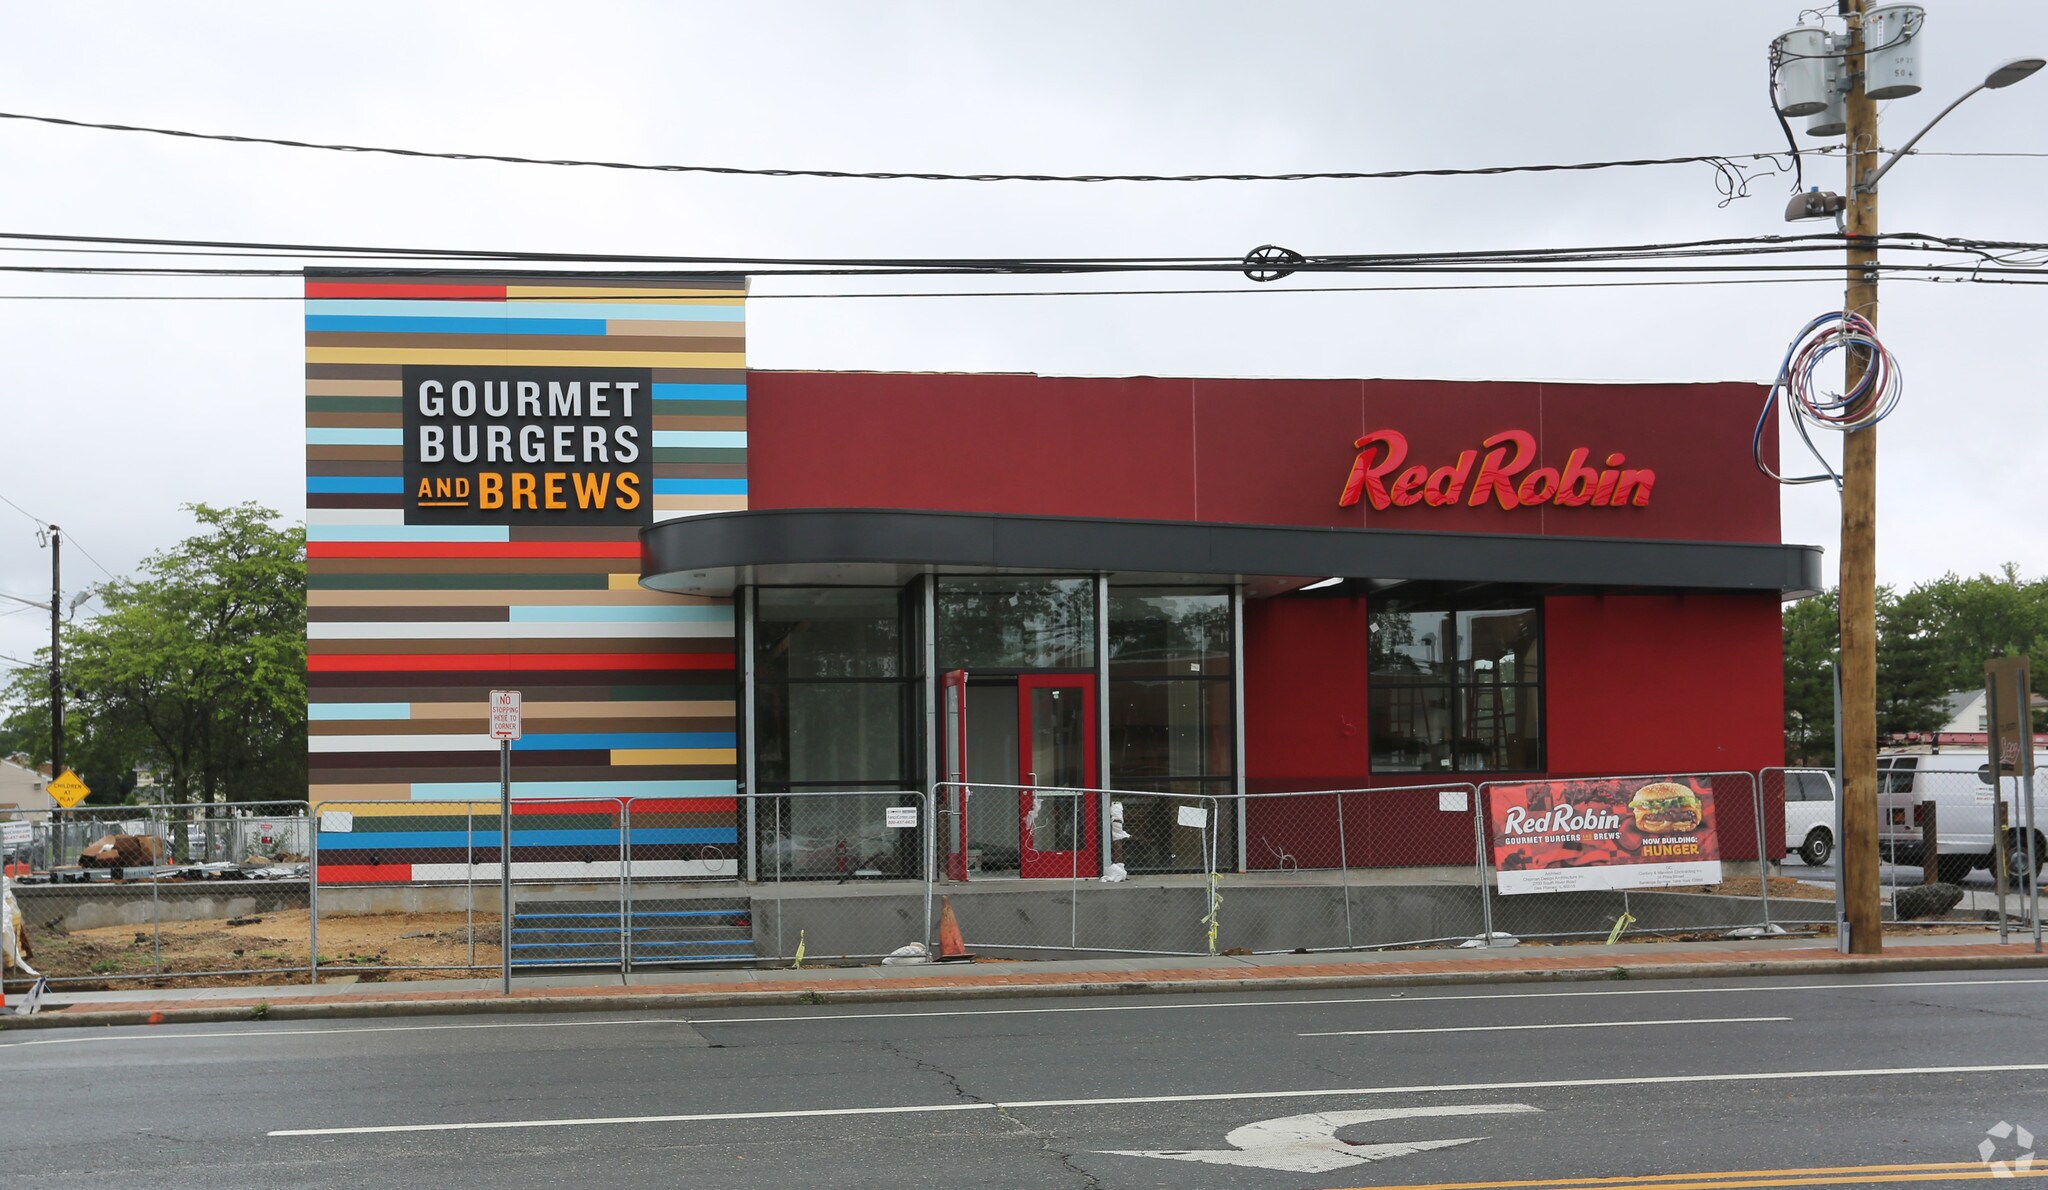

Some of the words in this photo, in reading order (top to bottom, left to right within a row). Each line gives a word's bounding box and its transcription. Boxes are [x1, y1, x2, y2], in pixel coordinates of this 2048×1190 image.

[418, 379, 640, 418] GOURMET
[419, 424, 640, 464] BURGERS
[1338, 429, 1478, 511] Red
[1467, 429, 1656, 511] Robin
[417, 477, 471, 499] AND
[478, 471, 641, 511] BREWS
[499, 695, 511, 705] NO
[493, 714, 508, 722] HERE
[510, 714, 517, 722] TO
[494, 722, 517, 730] CORNER
[1504, 806, 1552, 835] Red
[1552, 803, 1620, 832] Robin
[1505, 836, 1543, 845] GOURMET
[1544, 834, 1581, 843] BURGERS
[1593, 832, 1621, 841] BREWS
[1661, 836, 1698, 844] BUILDING:
[1643, 843, 1700, 857] HUNGER
